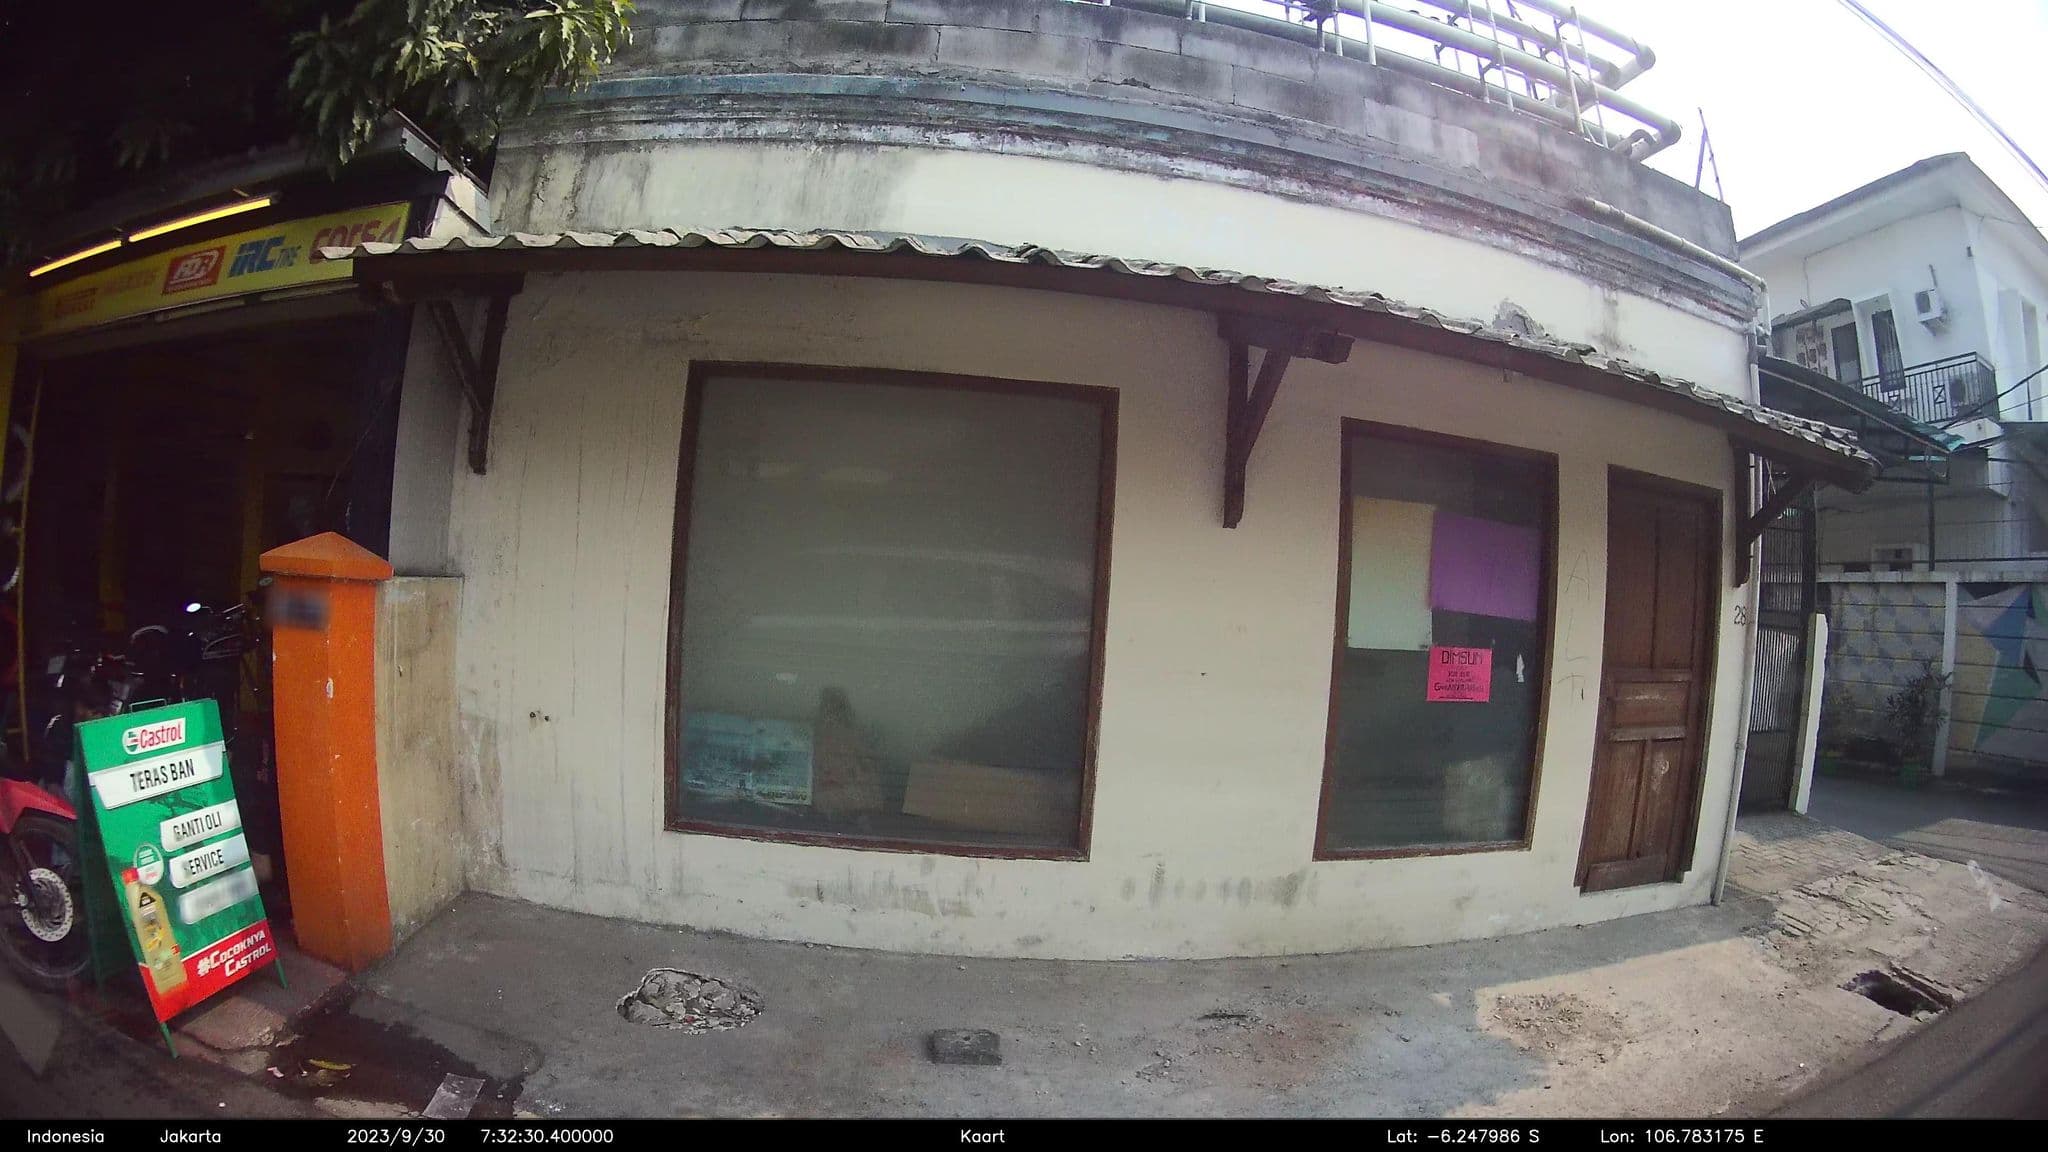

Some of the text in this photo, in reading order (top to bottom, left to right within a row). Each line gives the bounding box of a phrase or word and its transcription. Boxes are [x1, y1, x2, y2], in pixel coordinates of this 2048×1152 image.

[139, 722, 184, 749] Castrol
[129, 757, 195, 793] TERAS BAN
[173, 811, 223, 842] GANTI OLI
[184, 848, 225, 878] ERVICE
